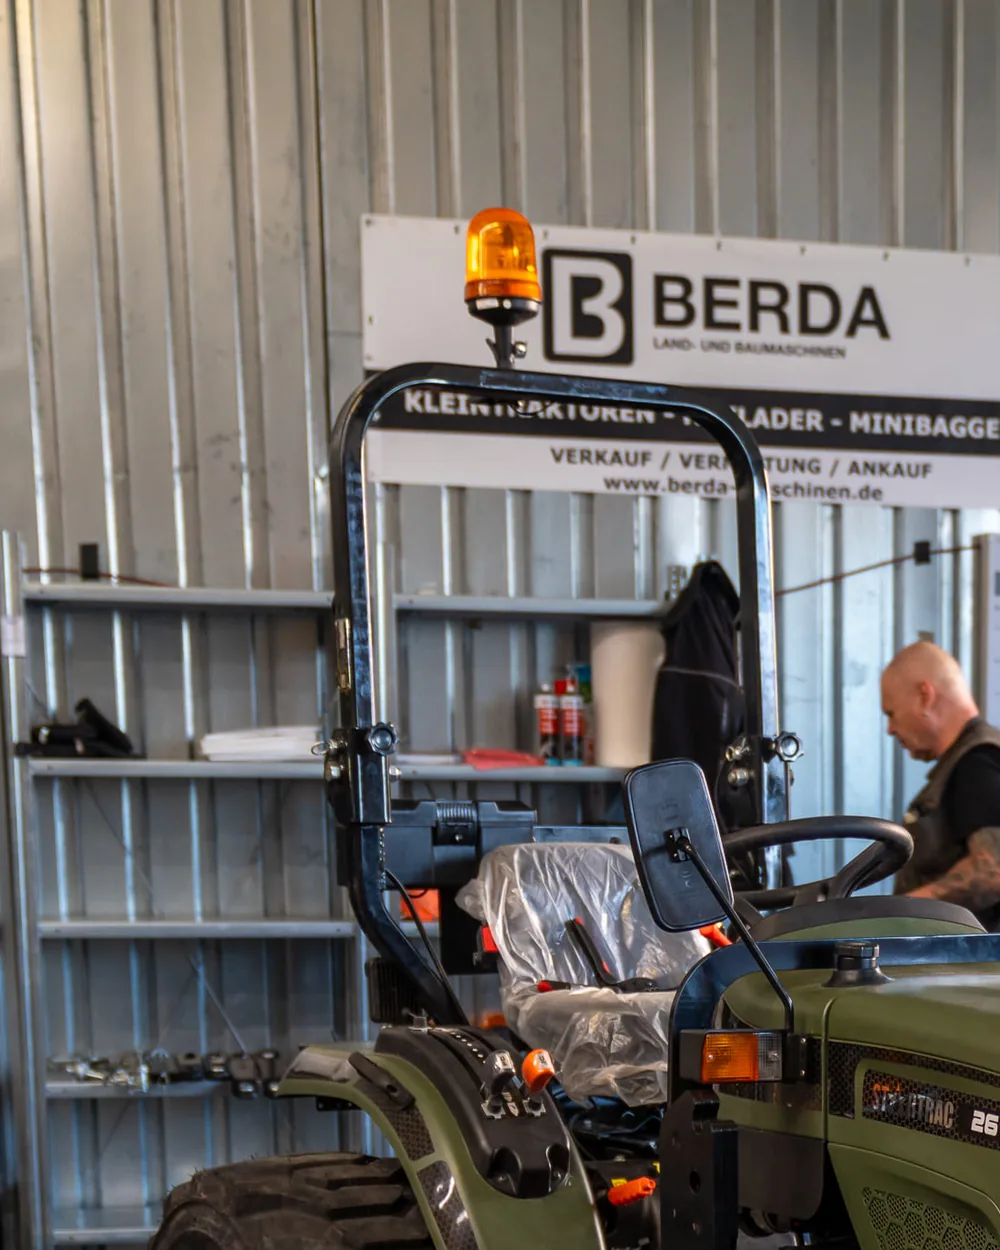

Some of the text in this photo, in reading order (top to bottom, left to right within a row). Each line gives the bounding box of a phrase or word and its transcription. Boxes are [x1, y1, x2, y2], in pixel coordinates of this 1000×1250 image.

[551, 255, 626, 358] B
[653, 273, 892, 341] BERDA
[653, 337, 847, 359] LAND- UND BAUMASCHINEN
[551, 447, 652, 468] VERKAUF
[848, 460, 933, 479] ANKAUF
[971, 1109, 1000, 1137] 26
